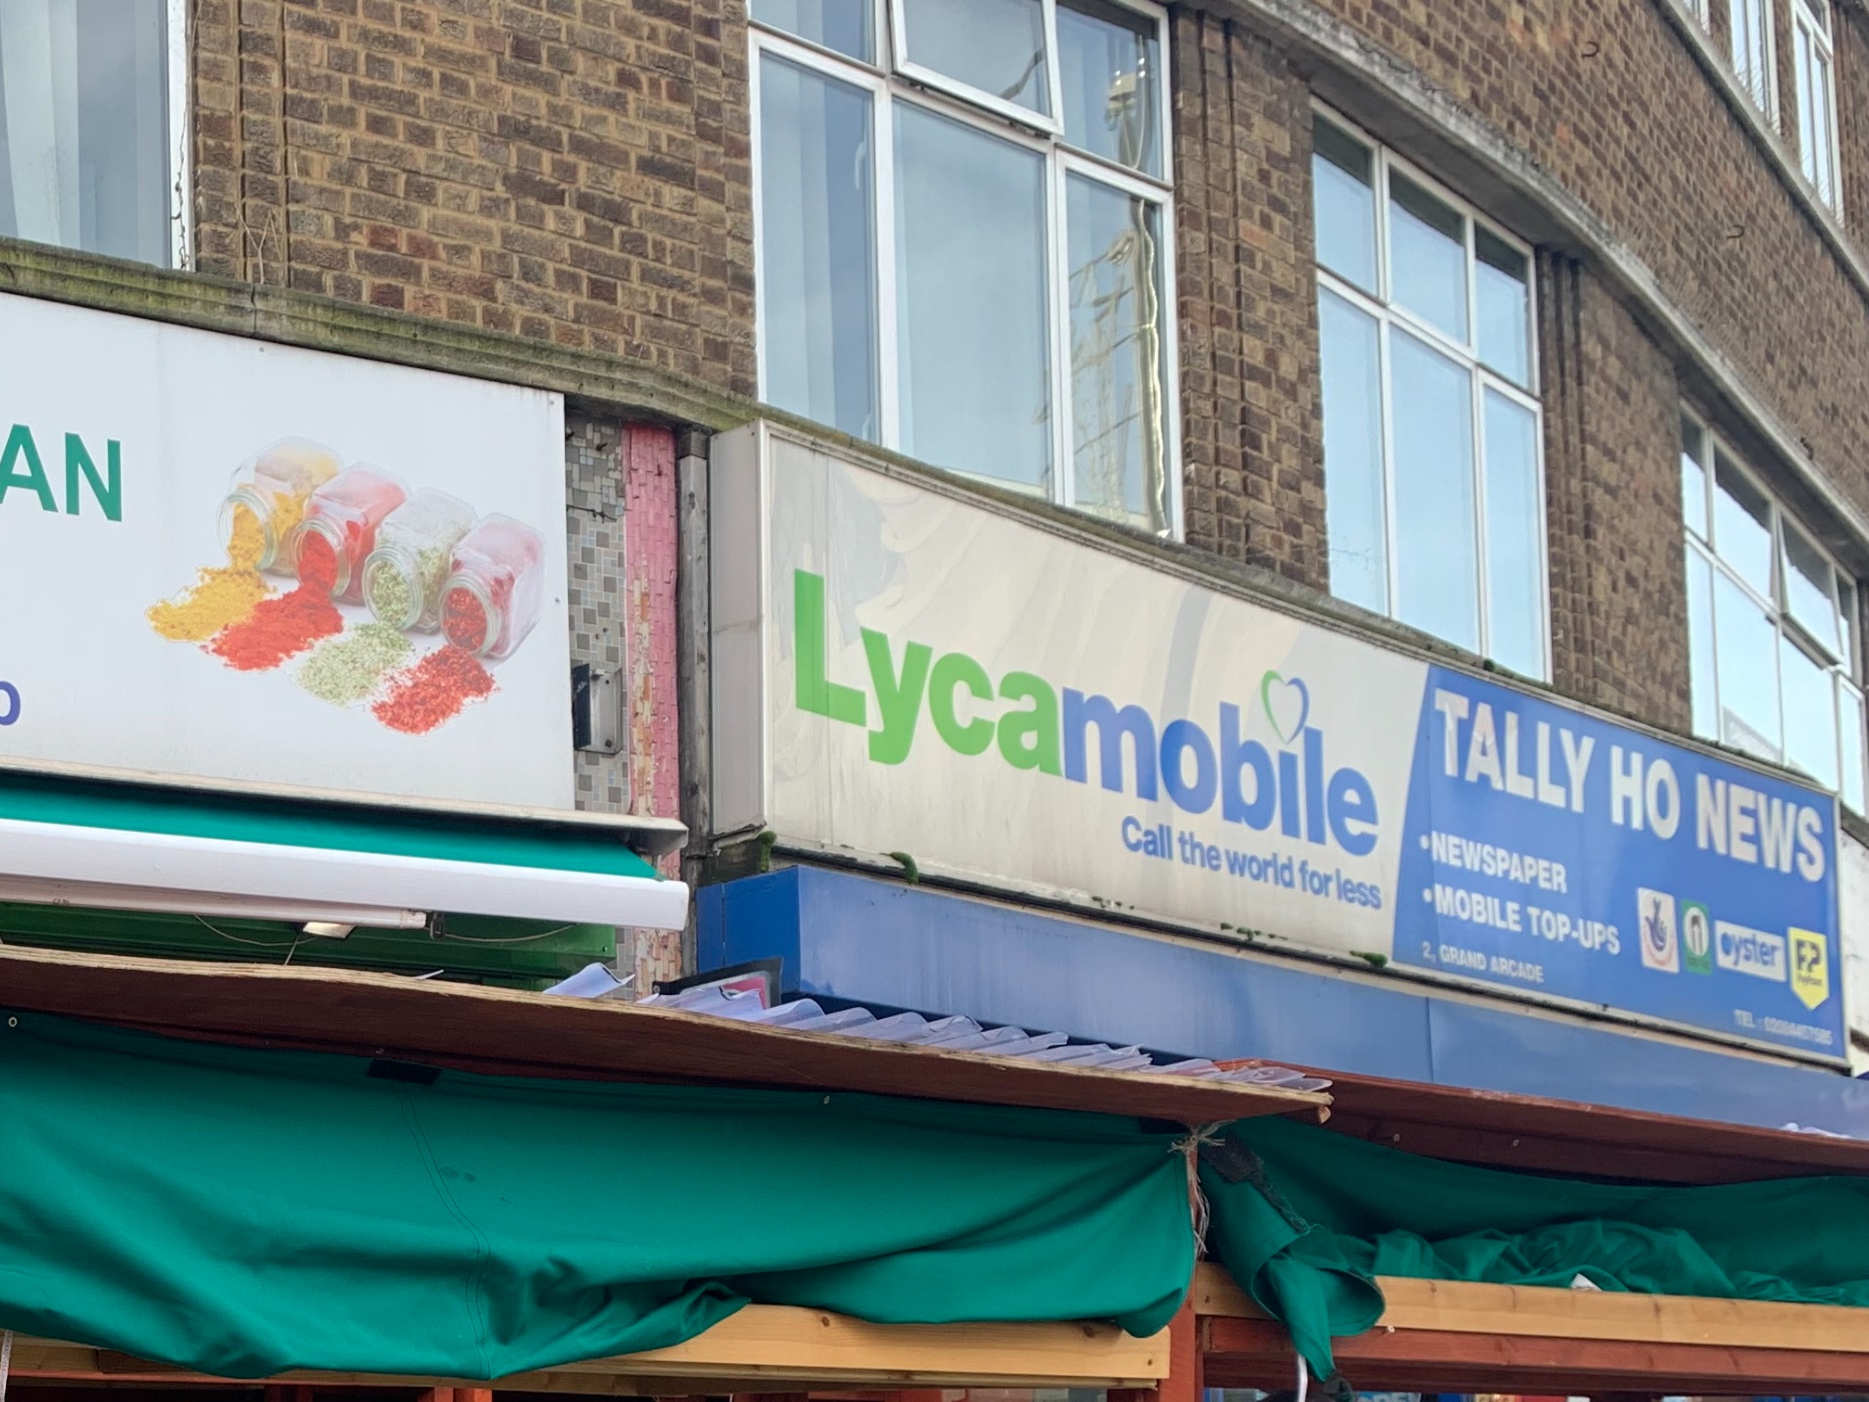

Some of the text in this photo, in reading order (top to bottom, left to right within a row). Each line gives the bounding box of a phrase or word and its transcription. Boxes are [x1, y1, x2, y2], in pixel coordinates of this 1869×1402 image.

[794, 568, 1379, 857] Lycamobile
[1434, 687, 1826, 883] TALLY HO NEWS
[1121, 815, 1382, 911] Call the world for less
[1431, 830, 1568, 894] NEWSPAPER
[1434, 883, 1621, 955] MOBILE TOP-UPS
[1439, 944, 1487, 971] GRAND
[1490, 956, 1545, 983] ARCADE
